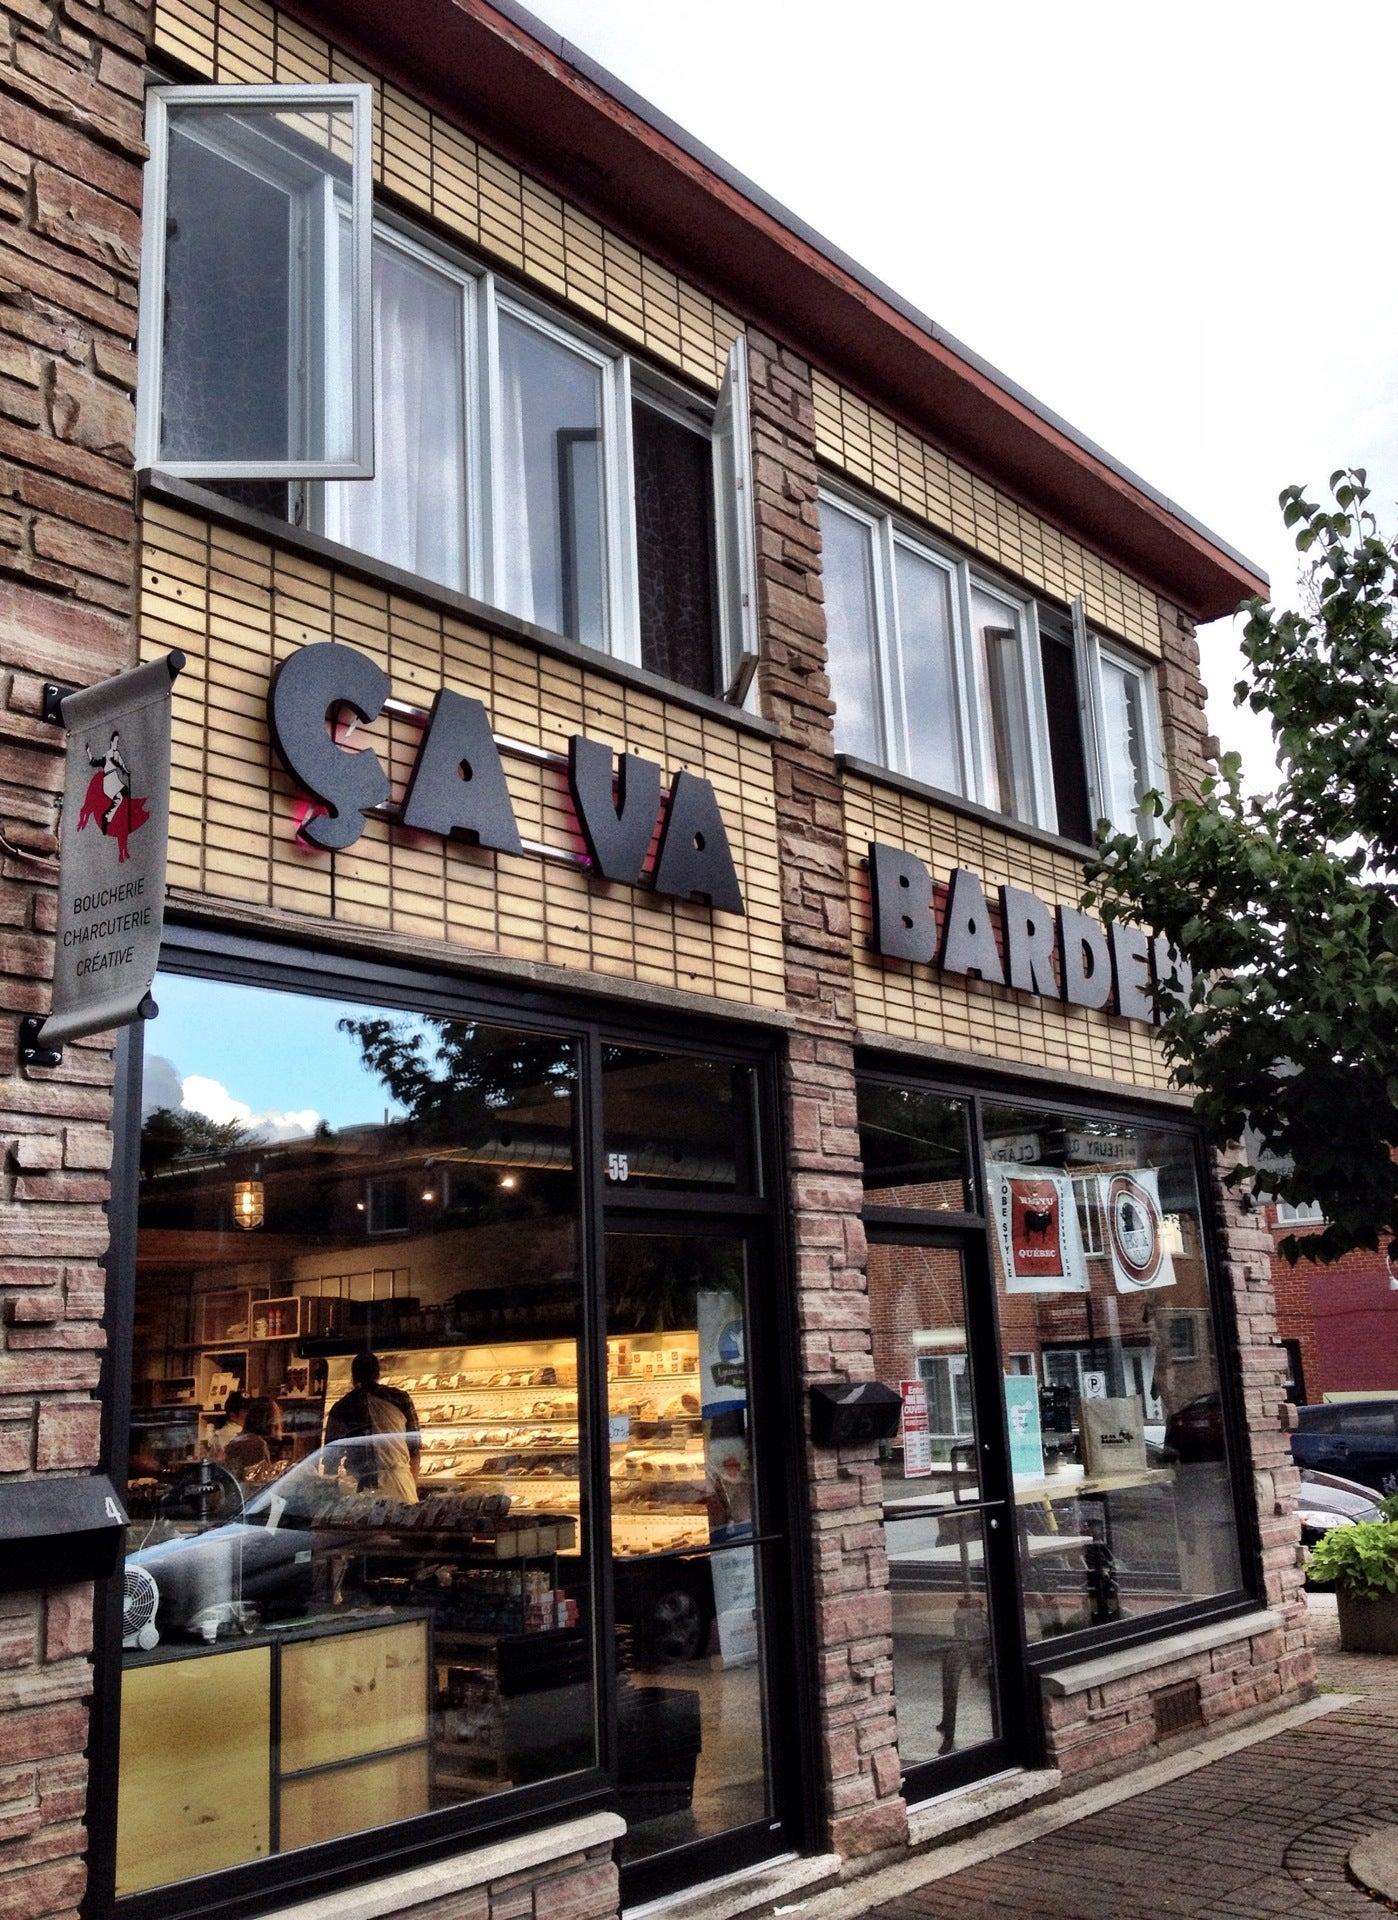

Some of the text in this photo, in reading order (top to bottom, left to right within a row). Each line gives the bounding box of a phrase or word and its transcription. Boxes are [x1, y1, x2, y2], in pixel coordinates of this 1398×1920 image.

[267, 642, 523, 857] ÇA
[568, 735, 746, 916] VA
[73, 877, 145, 915] BOUCHERIE
[63, 906, 151, 947] CHARCUTERIE
[76, 946, 134, 976] CRÉATIVE
[608, 1153, 629, 1181] 55
[104, 1496, 123, 1524] 4
